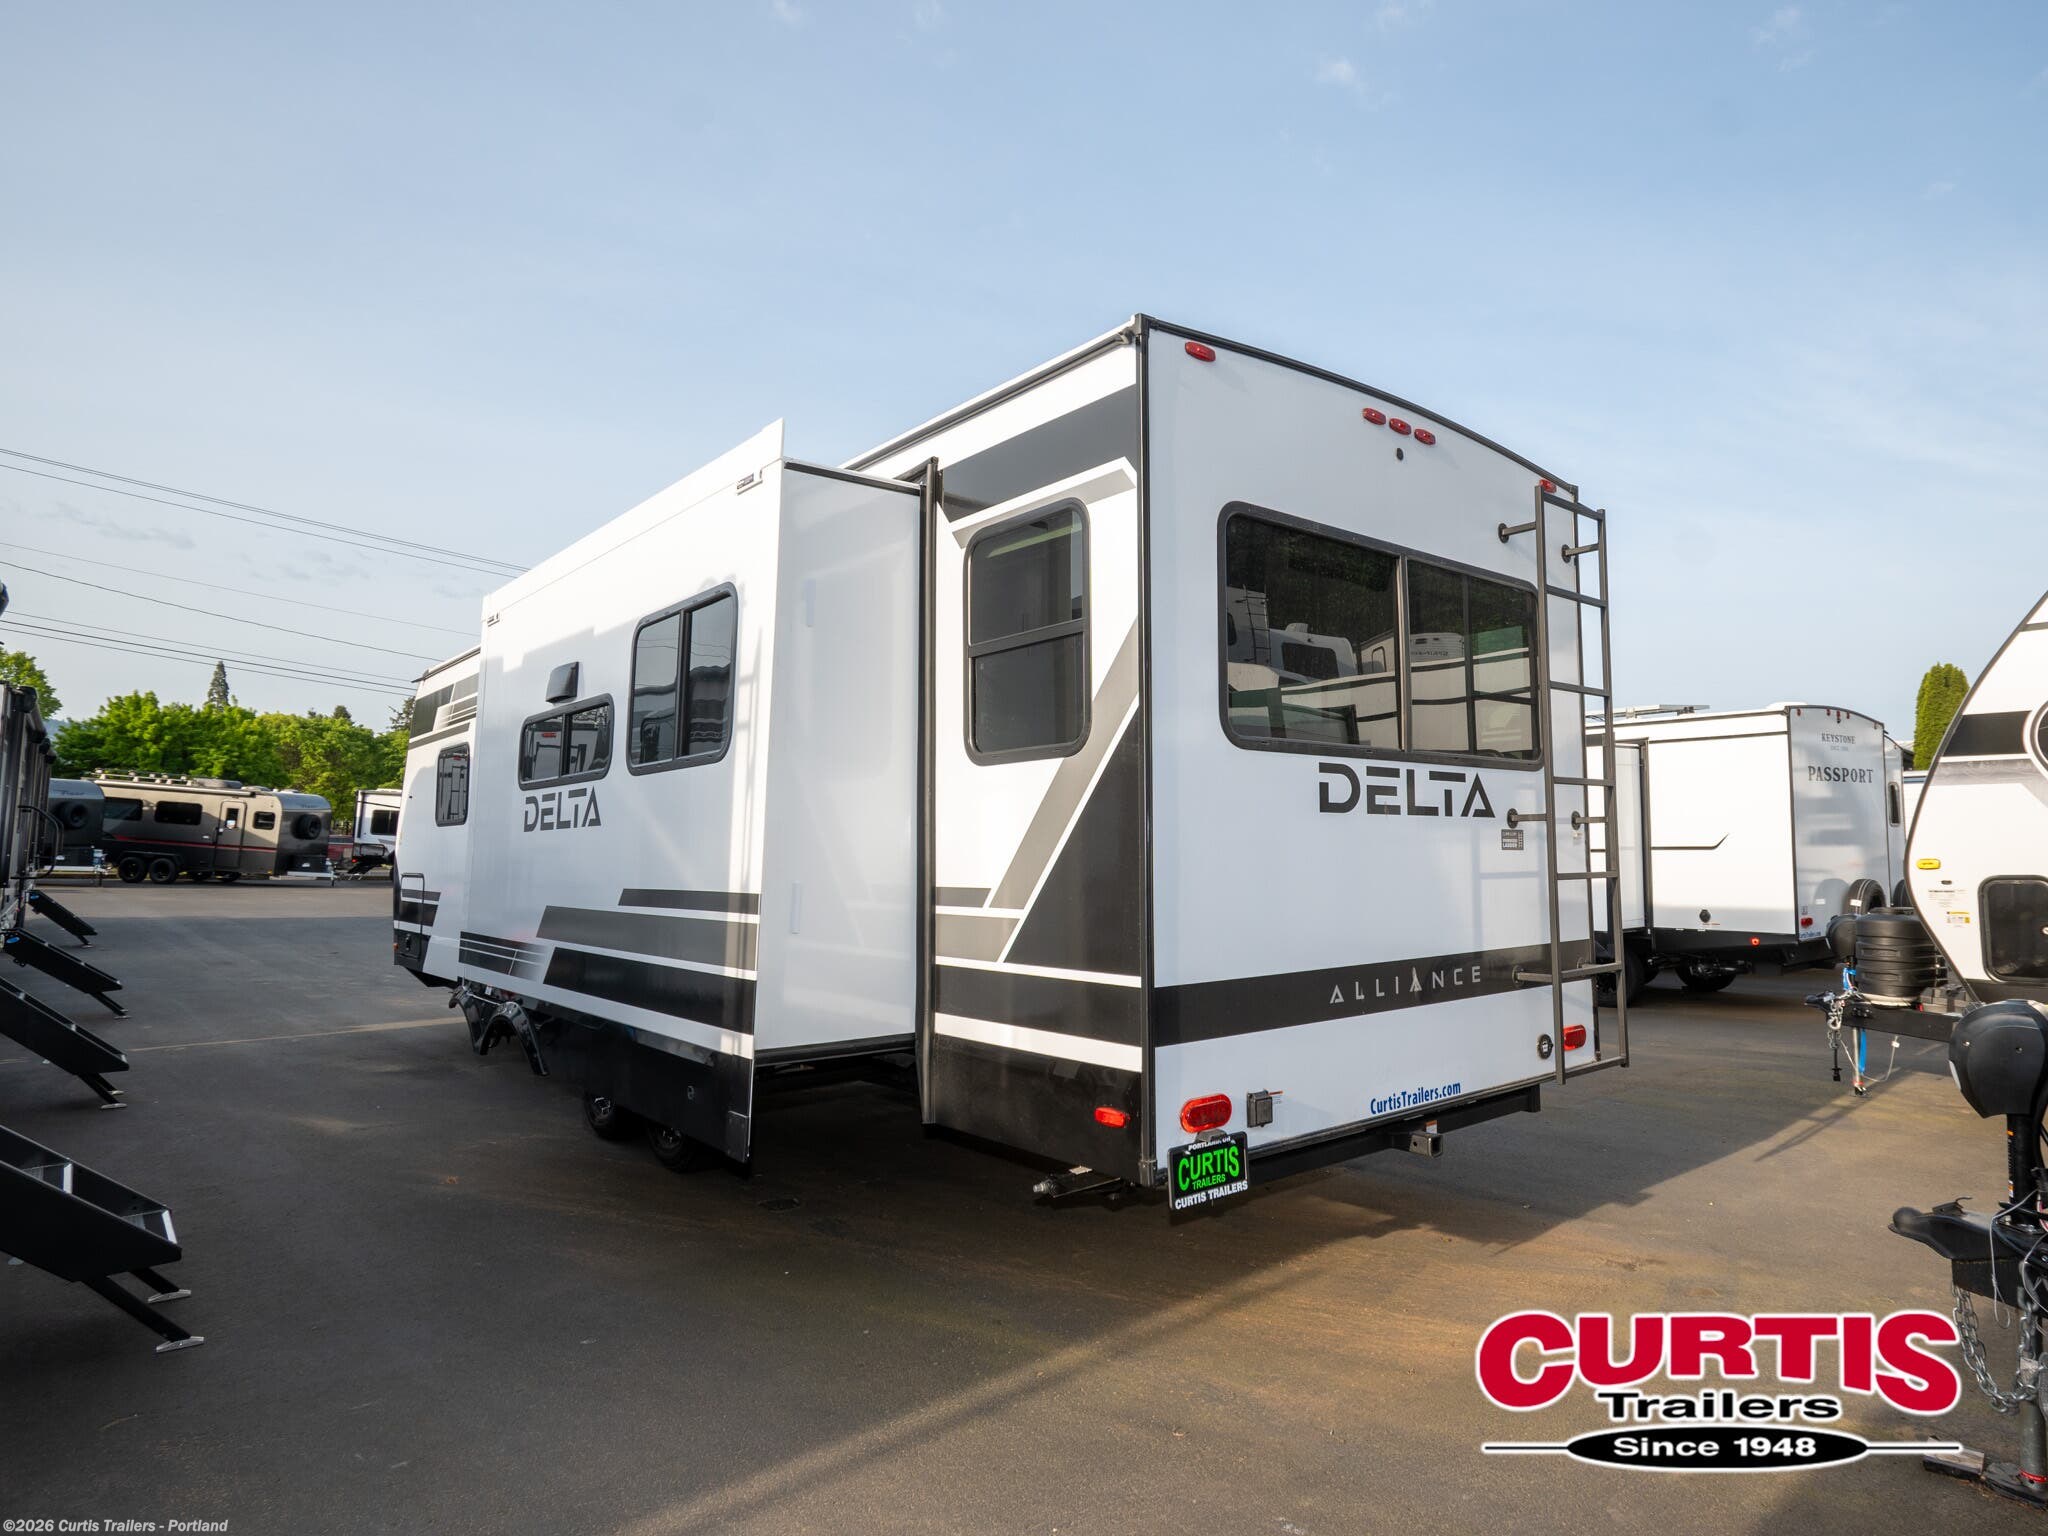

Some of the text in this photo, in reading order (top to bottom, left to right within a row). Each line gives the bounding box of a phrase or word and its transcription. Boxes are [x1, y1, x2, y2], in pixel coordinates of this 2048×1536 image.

[1821, 733, 1856, 744] KEYSTONE
[1318, 761, 1496, 818] DELTA
[1807, 765, 1873, 783] PASSPORT
[523, 785, 602, 832] DELTA
[1329, 965, 1481, 1004] ALLIANCE
[1370, 1082, 1461, 1114] CurtisTrailers.com
[1178, 1145, 1239, 1190] CURTIS
[1192, 1174, 1225, 1190] TRAILERS
[1175, 1180, 1248, 1209] CURTIS TRAILERS
